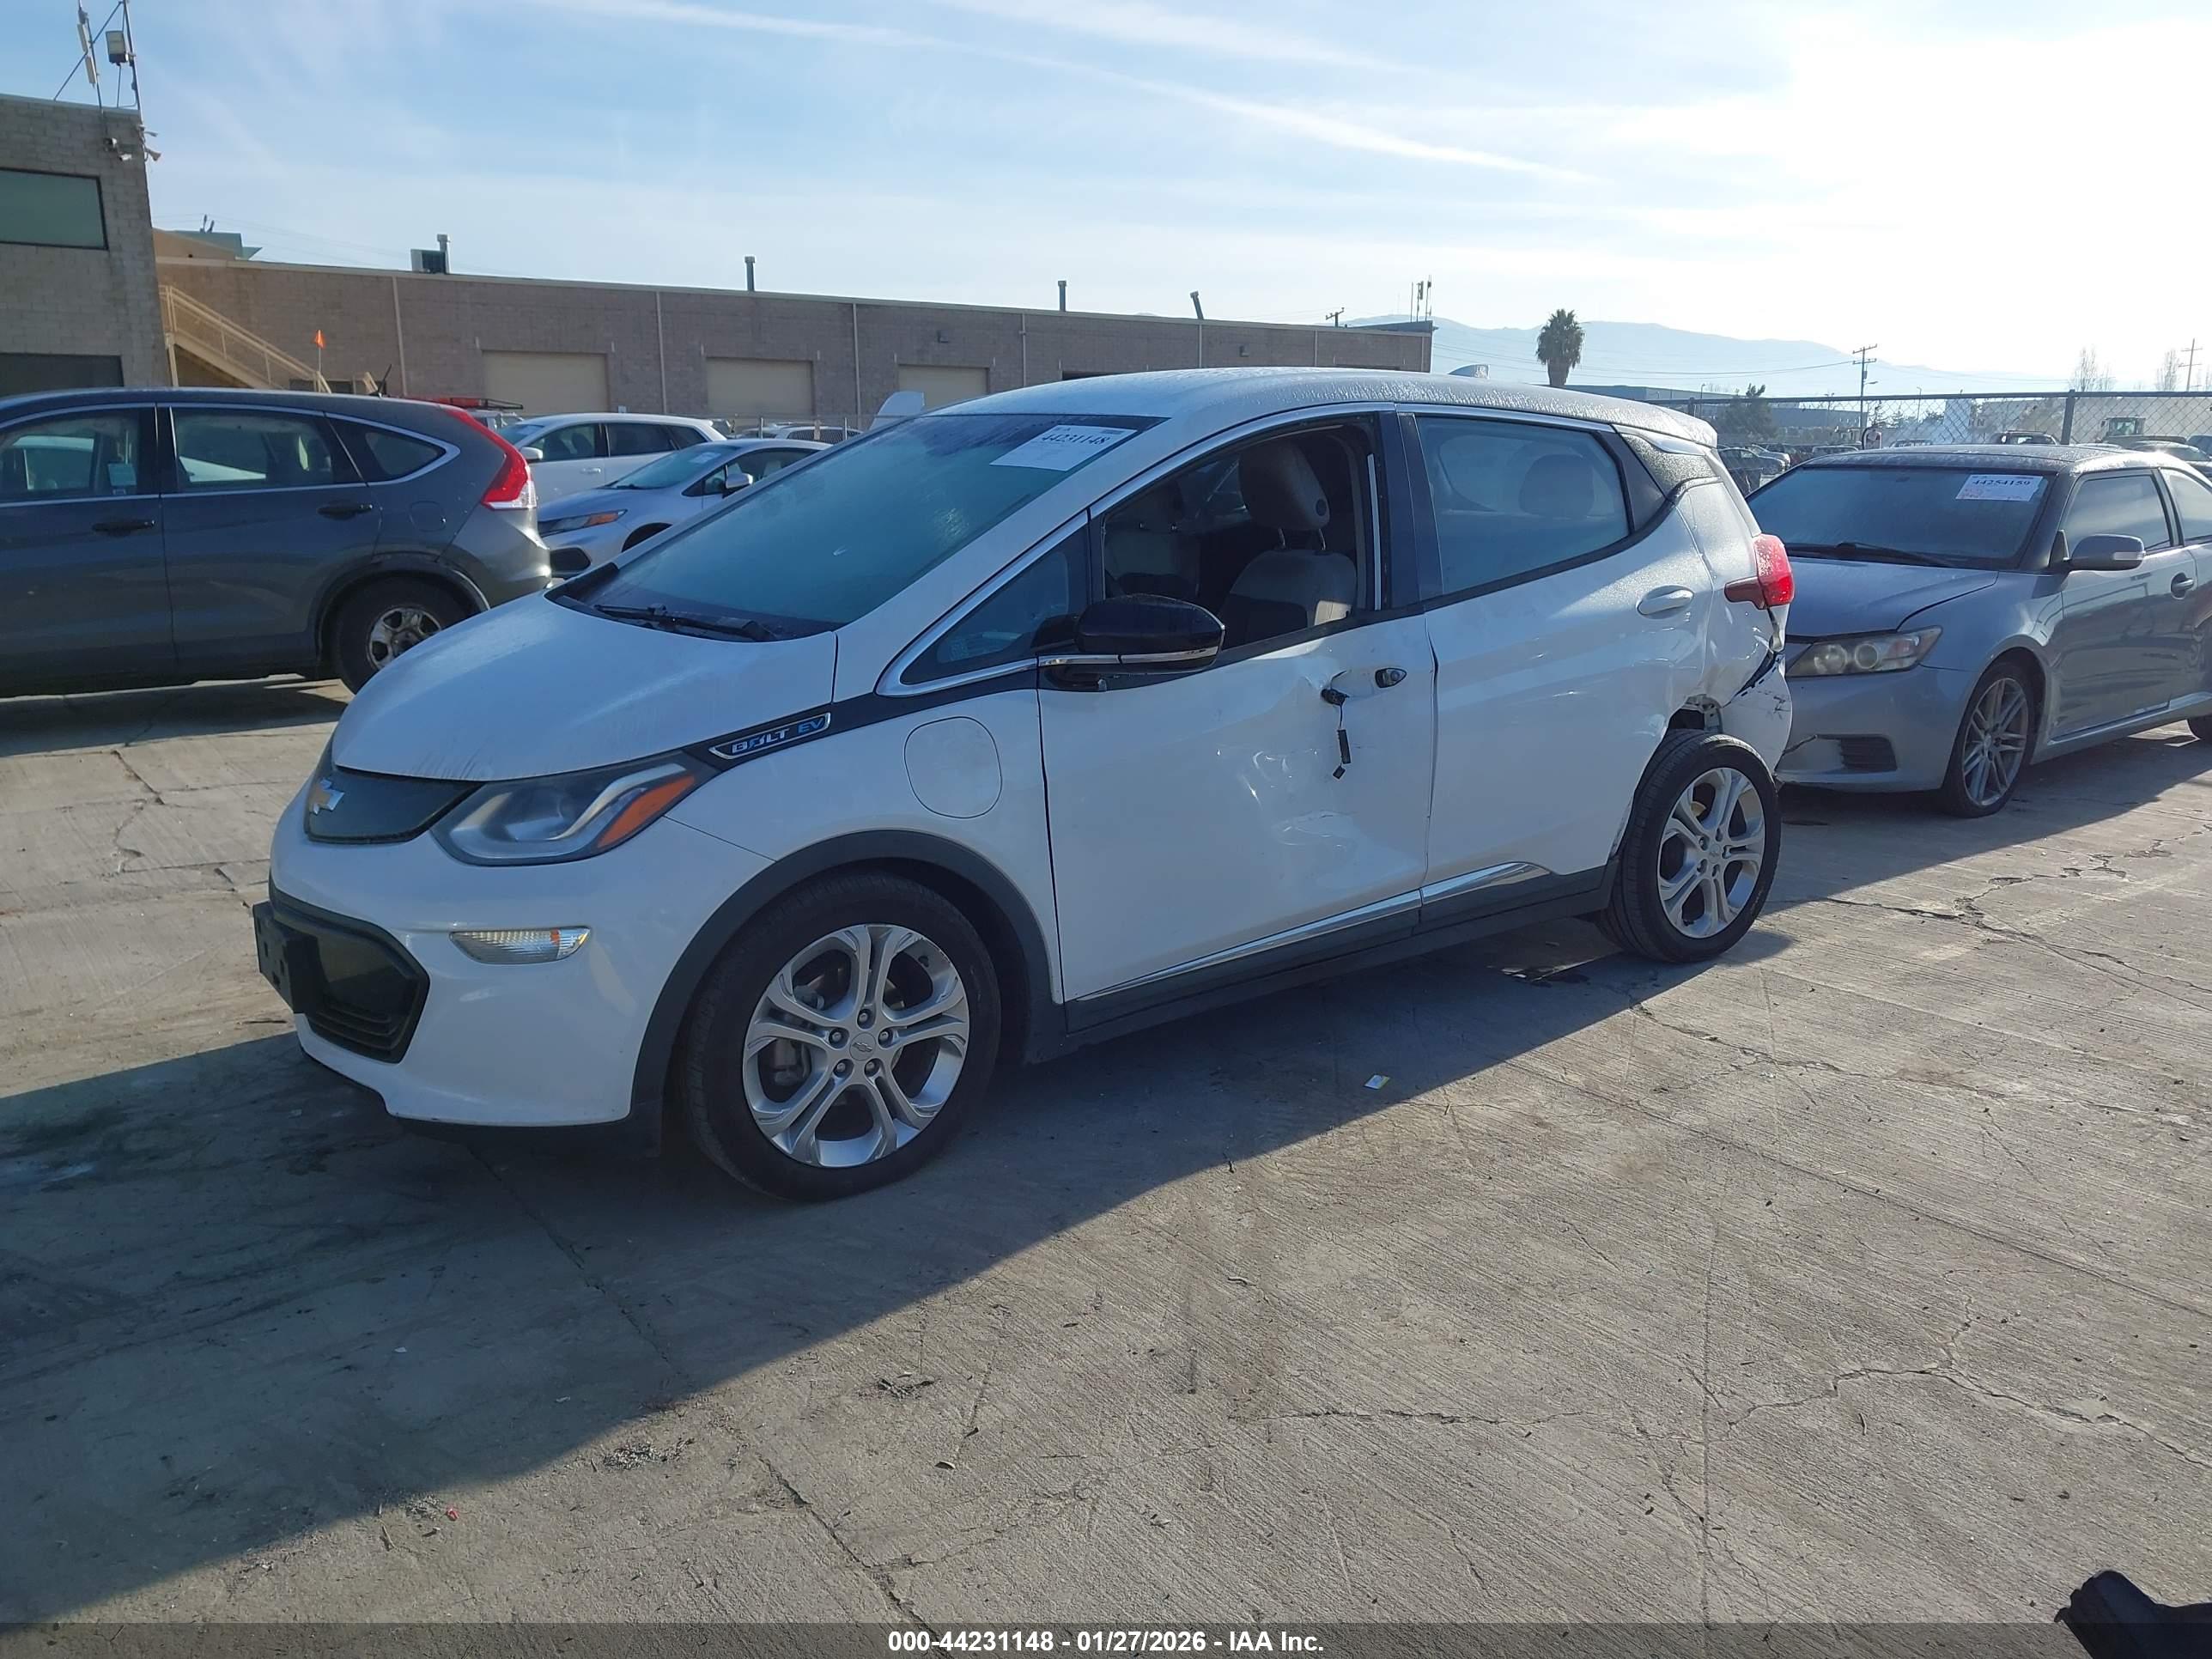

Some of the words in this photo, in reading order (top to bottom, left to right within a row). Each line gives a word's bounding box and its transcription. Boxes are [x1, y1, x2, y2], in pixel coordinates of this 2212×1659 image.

[1041, 433, 1111, 446] 44231148
[732, 728, 790, 754] BOLT
[798, 718, 824, 735] EV
